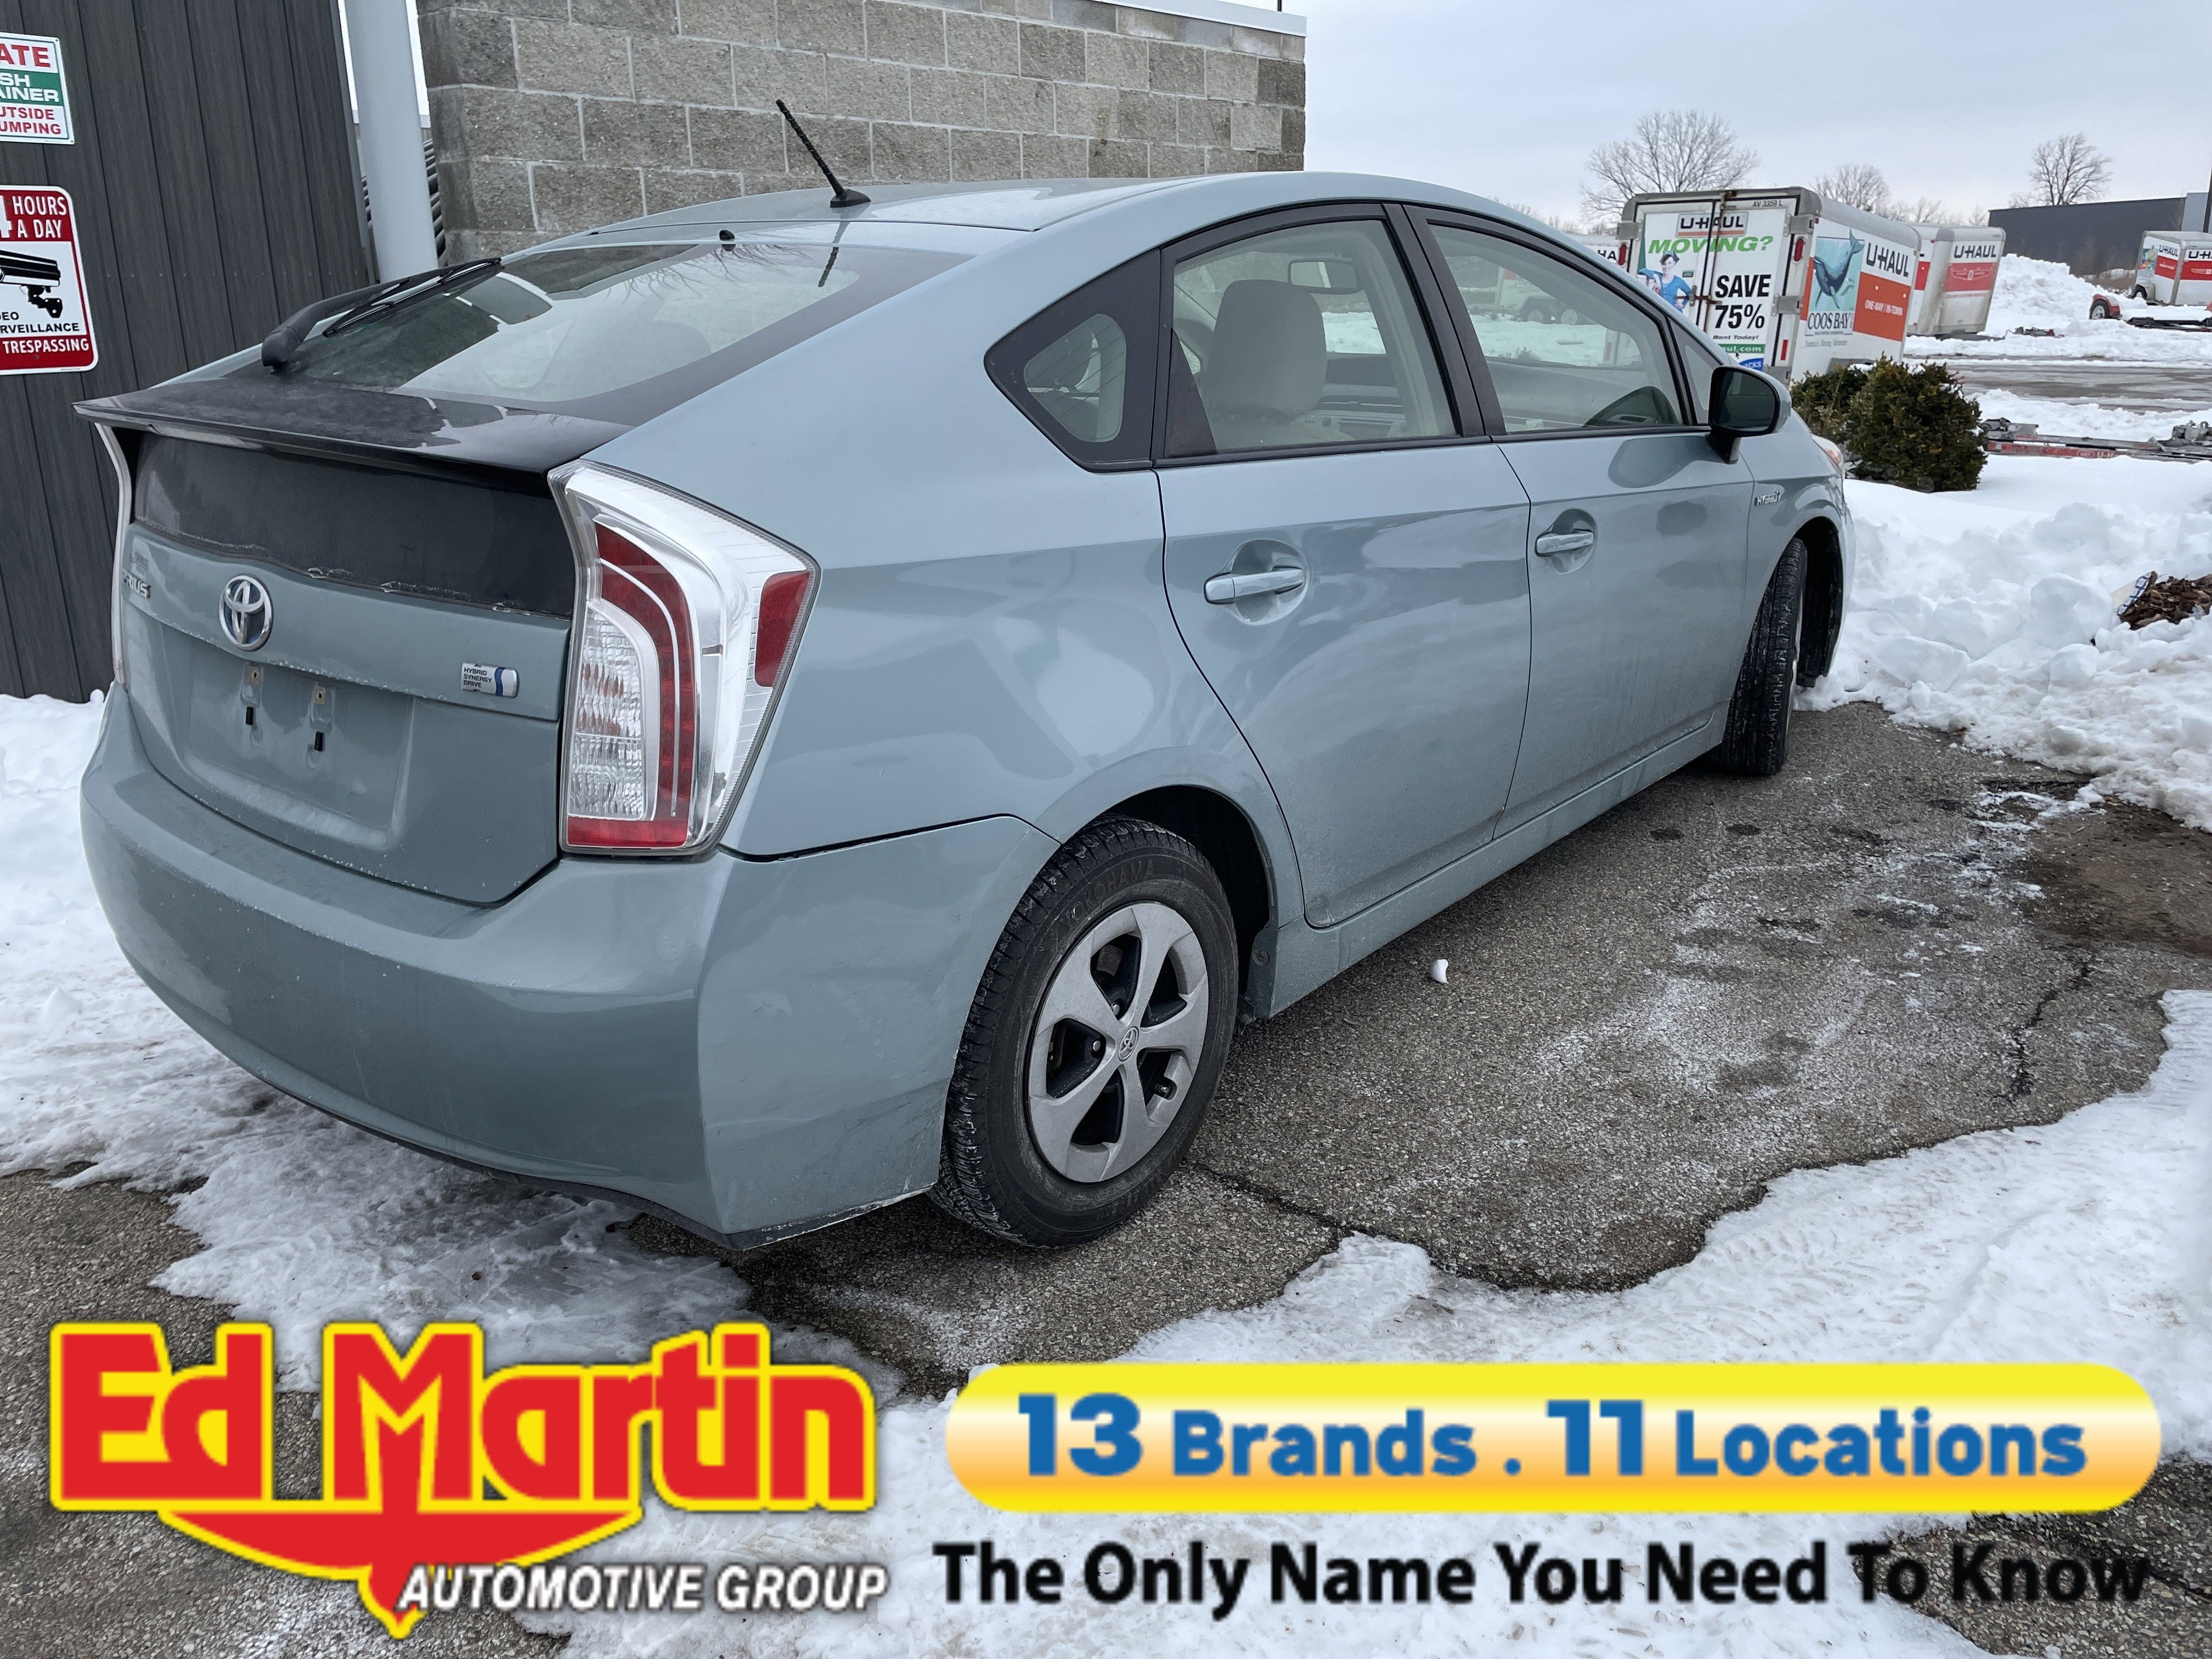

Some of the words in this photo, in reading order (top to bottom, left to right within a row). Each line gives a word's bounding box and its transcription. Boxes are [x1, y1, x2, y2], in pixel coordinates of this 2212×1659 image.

[12, 195, 67, 216] HOURS
[18, 219, 28, 238] A
[33, 219, 62, 238] DAY
[1681, 216, 1743, 229] U-HAUL
[1648, 236, 1773, 254] MOVING?
[1954, 245, 1996, 258] U-HAUL
[1866, 243, 1909, 278] U-HAUL
[2188, 251, 2212, 259] U-H
[1716, 274, 1771, 298] SAVE
[0, 312, 19, 320] EO
[1716, 304, 1765, 329] 75%
[1808, 313, 1833, 329] COOS
[2, 338, 89, 354] TRESPASSING
[464, 667, 487, 676] HYBRID
[464, 674, 492, 683] SYNERGY
[464, 680, 482, 688] DRIVE
